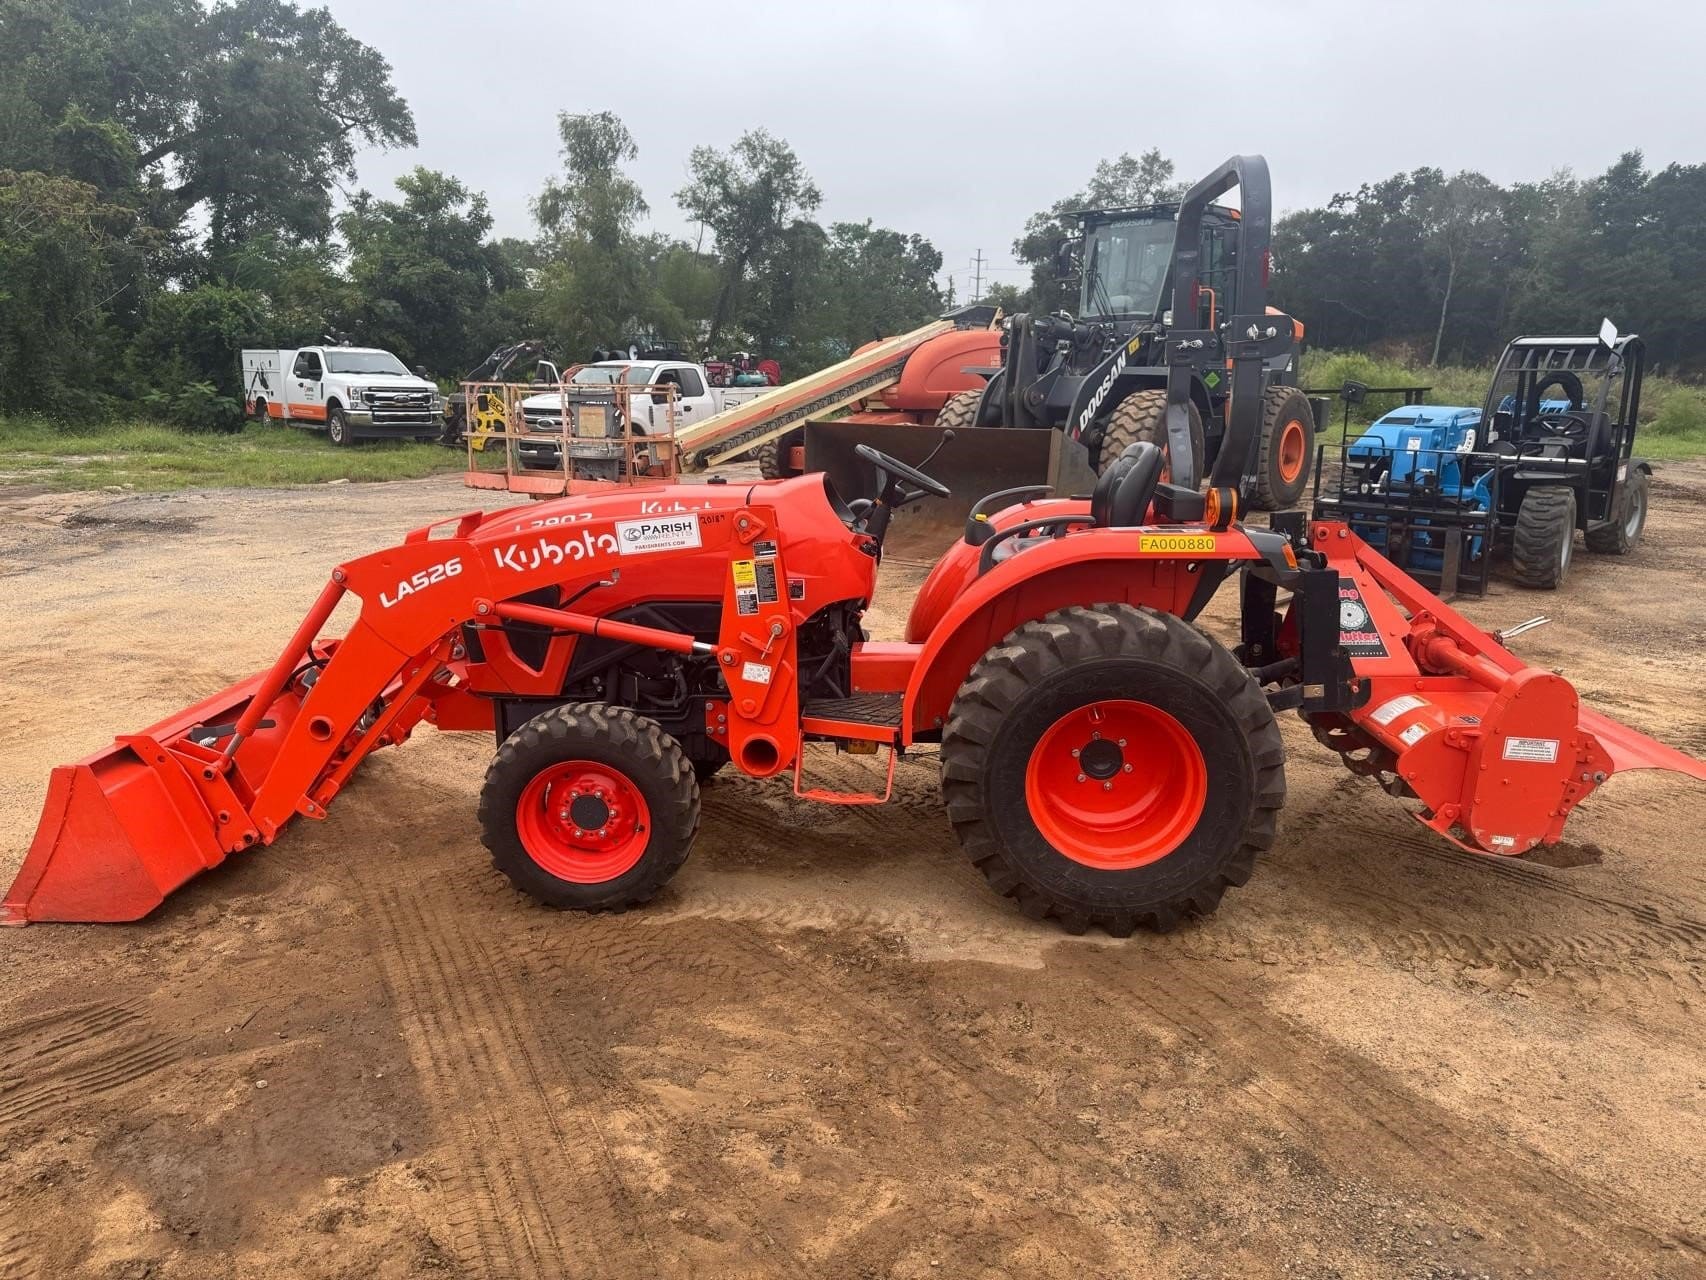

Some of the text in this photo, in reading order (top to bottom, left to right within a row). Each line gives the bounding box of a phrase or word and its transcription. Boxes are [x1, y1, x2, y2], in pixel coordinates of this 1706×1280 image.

[1079, 349, 1127, 433] DOOSAN
[641, 521, 693, 536] PARISH
[1140, 538, 1215, 550] FA000880
[493, 529, 620, 572] Kubota
[379, 556, 464, 609] LA526
